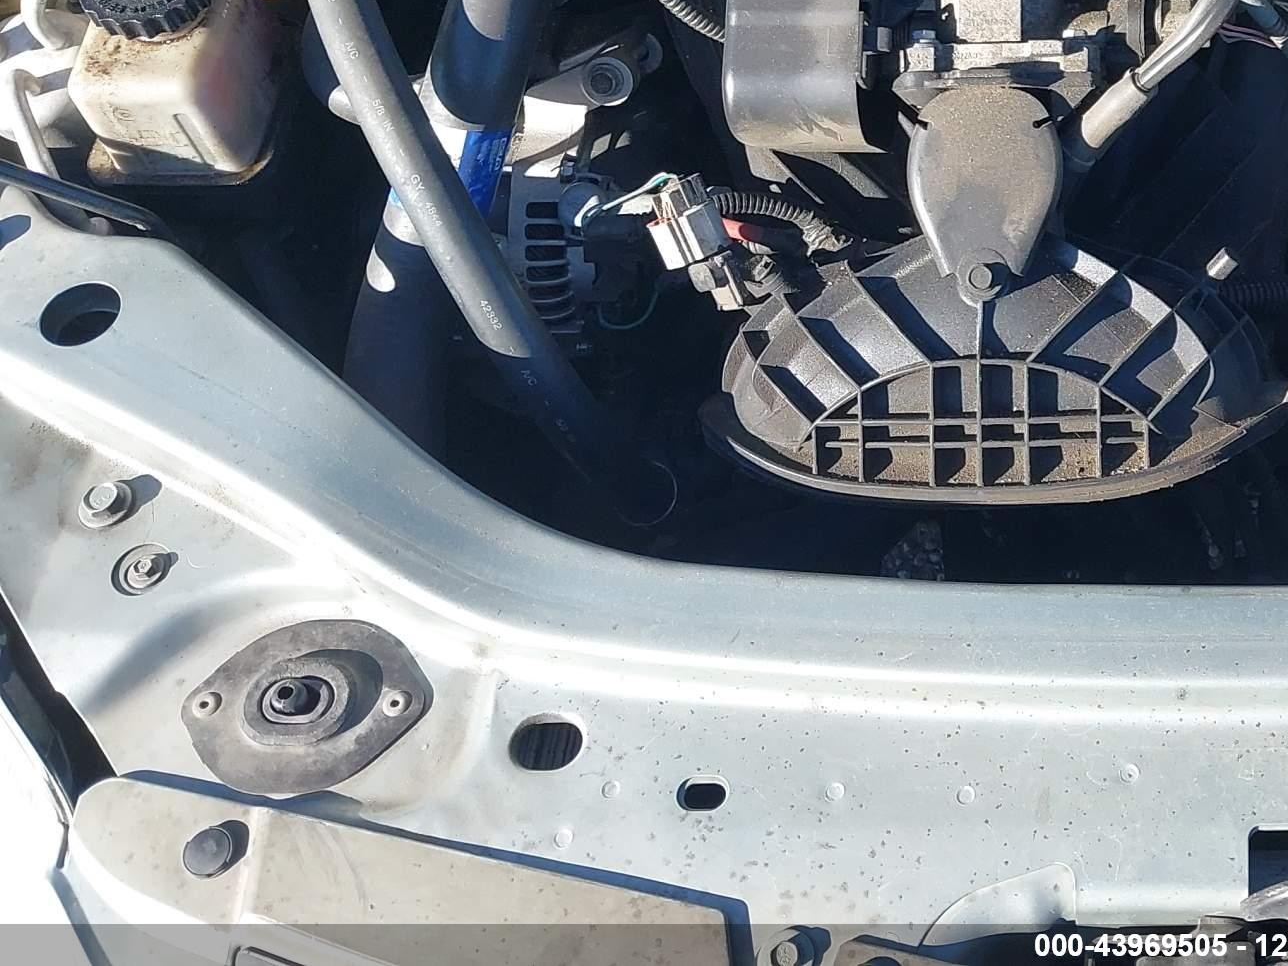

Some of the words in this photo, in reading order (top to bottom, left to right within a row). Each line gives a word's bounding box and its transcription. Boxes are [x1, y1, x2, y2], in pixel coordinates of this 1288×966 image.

[344, 41, 360, 60] A/C
[410, 174, 426, 192] GY
[480, 300, 503, 331] 42332
